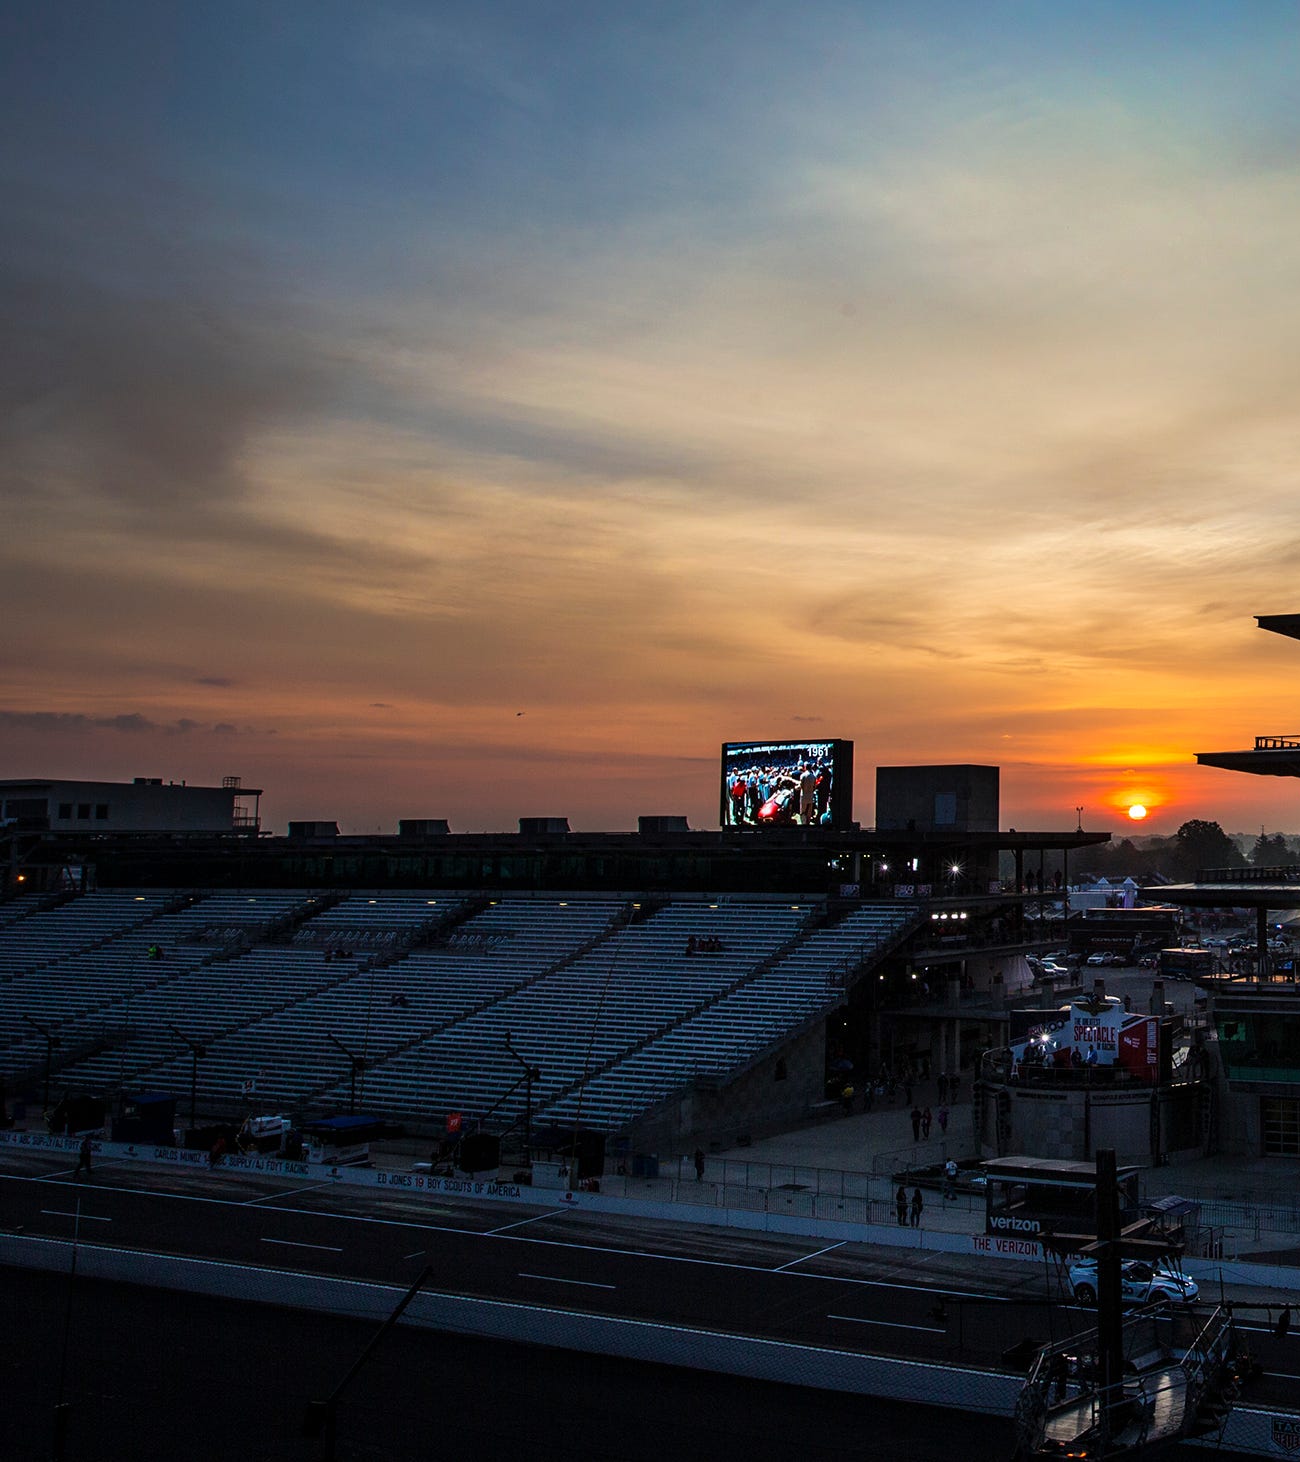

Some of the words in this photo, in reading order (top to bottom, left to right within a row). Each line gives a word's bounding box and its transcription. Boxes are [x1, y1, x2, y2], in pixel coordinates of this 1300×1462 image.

[806, 747, 829, 757] 1961
[1074, 1026, 1116, 1043] SPECTACLE
[154, 1149, 178, 1161] CARLOS
[266, 1160, 283, 1172] FOYT
[285, 1162, 309, 1175] RACING
[377, 1173, 388, 1184] ED
[388, 1174, 412, 1187] JONES
[414, 1178, 424, 1188] 19
[427, 1178, 442, 1189] BOY
[443, 1180, 472, 1193] SCOUTS
[474, 1183, 484, 1194] OF
[486, 1184, 521, 1198] AMERICA
[989, 1215, 1041, 1233] verizon
[972, 1236, 992, 1251] THE
[996, 1239, 1039, 1256] VERIZON
